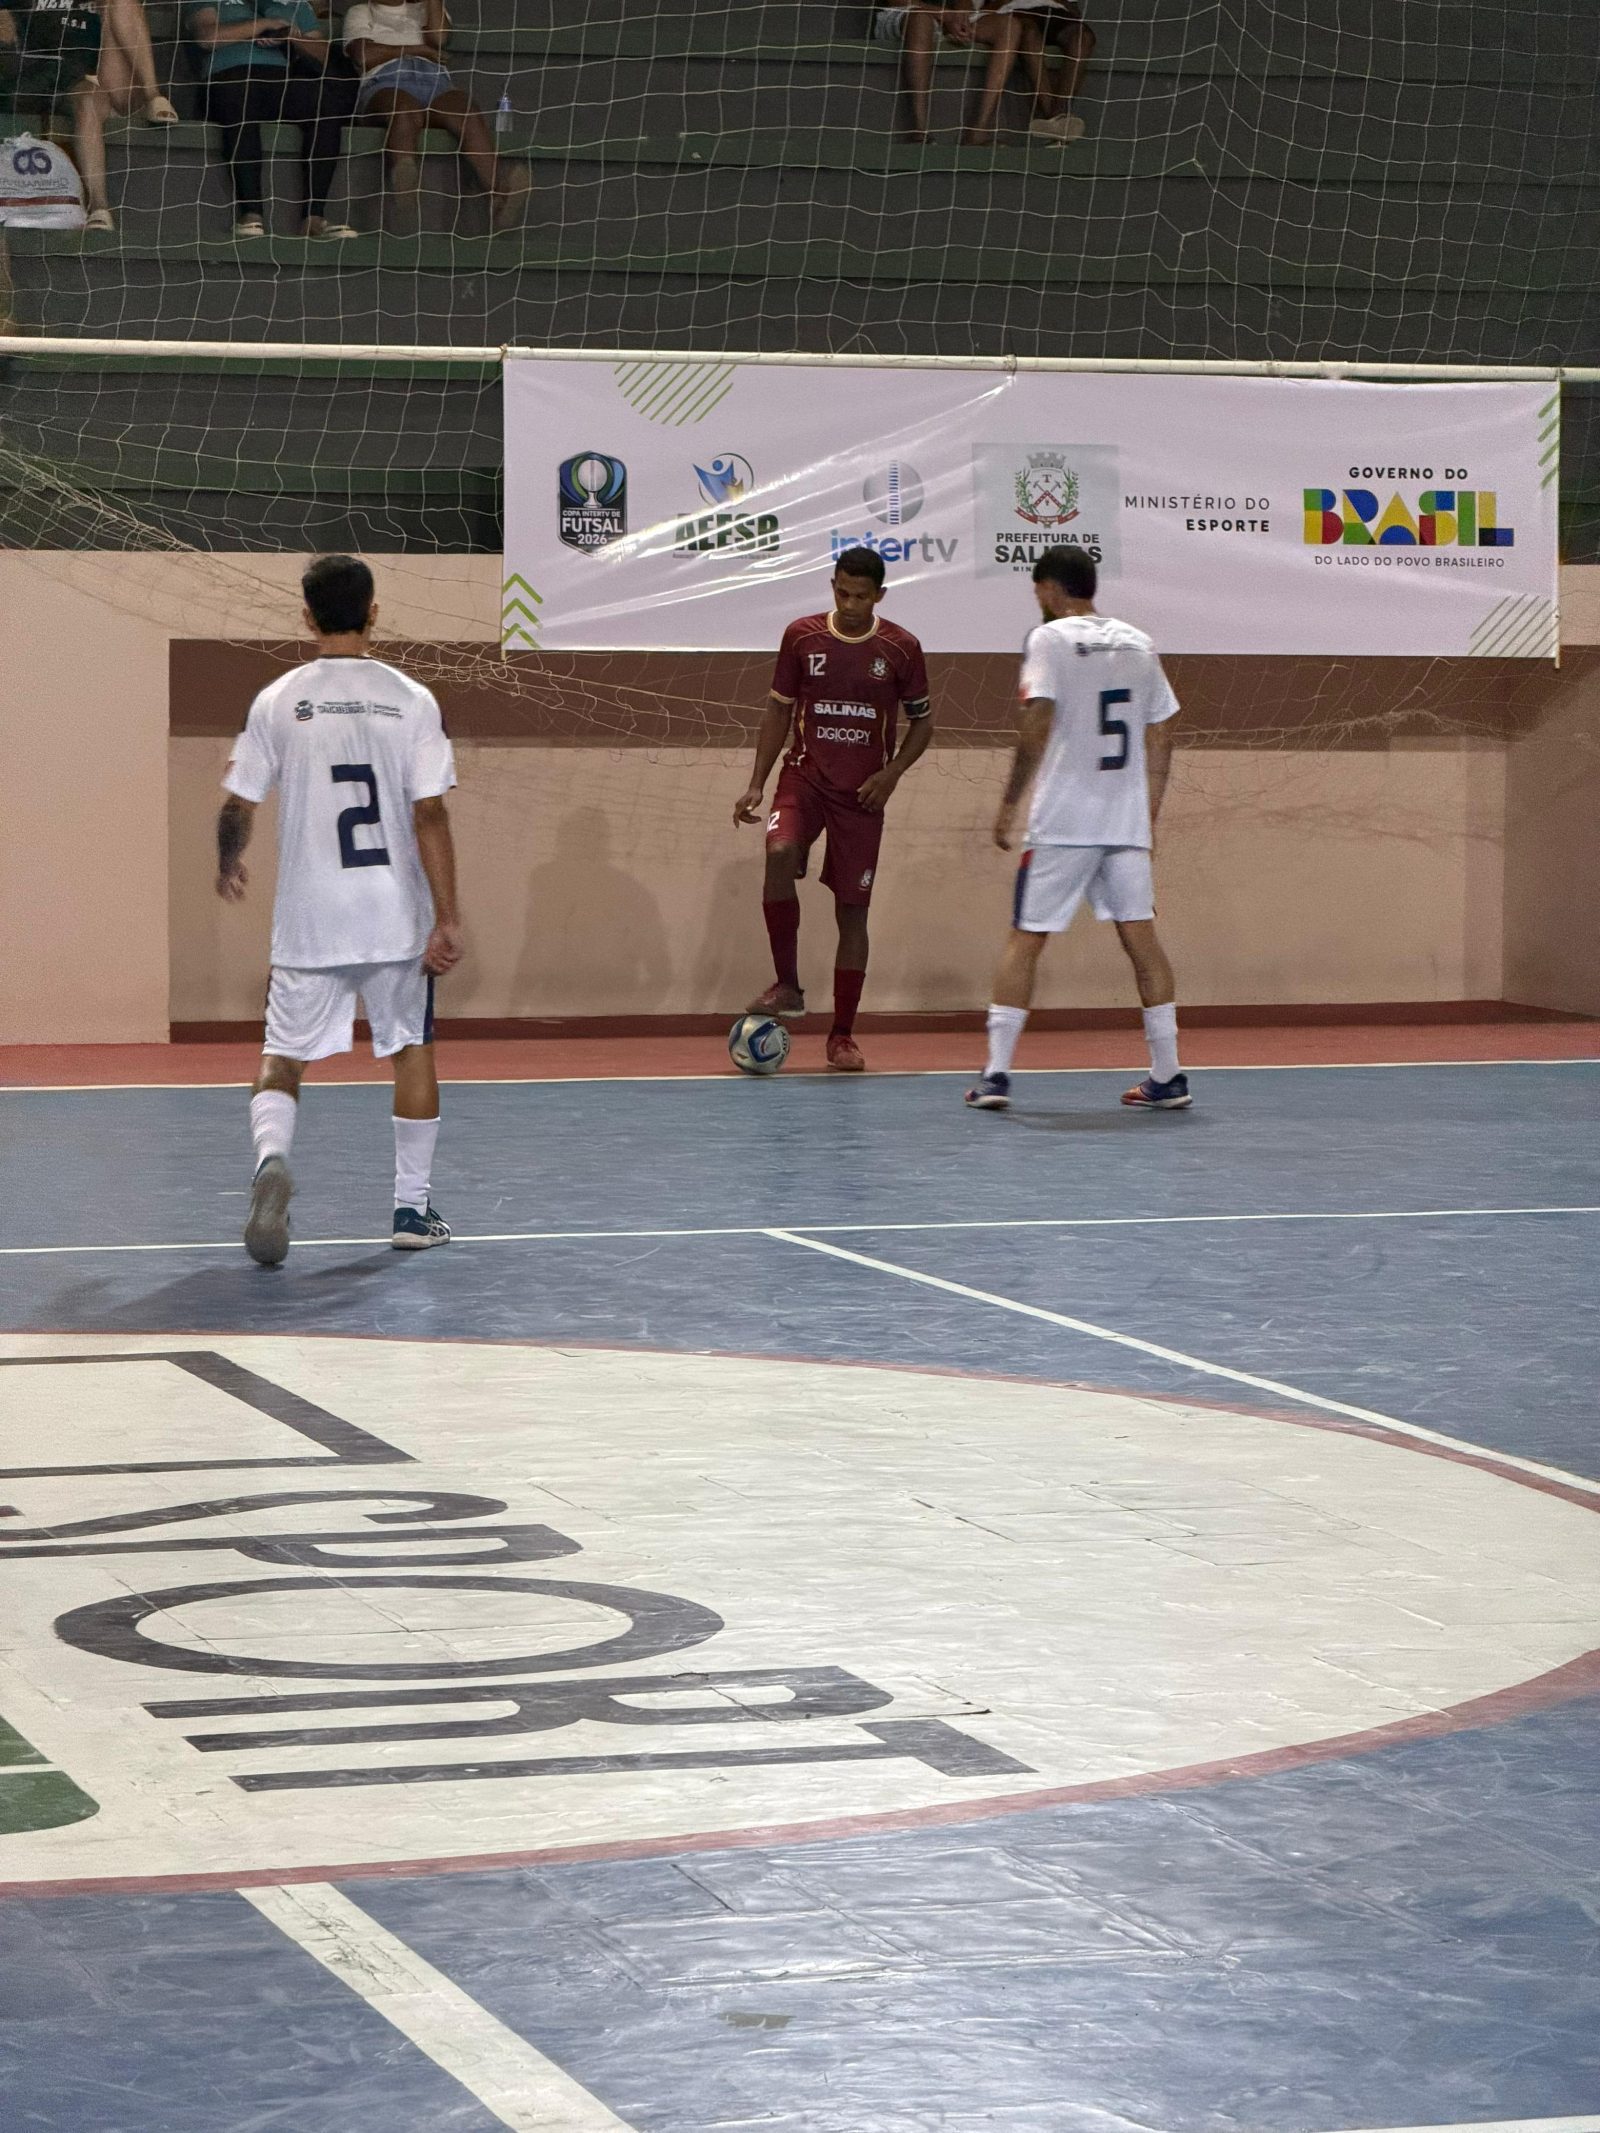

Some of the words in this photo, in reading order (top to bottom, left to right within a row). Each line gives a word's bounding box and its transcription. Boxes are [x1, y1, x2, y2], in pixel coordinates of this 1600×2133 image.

[1349, 467, 1434, 480] GOVERNO
[1445, 468, 1468, 480] DO
[1125, 494, 1236, 510] MINISTÉRIO
[1245, 498, 1270, 510] DO
[562, 518, 623, 533] FUTSAL
[1186, 519, 1270, 532] ESPORTE
[1303, 488, 1514, 547] BRASIL
[577, 534, 608, 545] 2026
[996, 533, 1079, 543] PREFEITURA
[1082, 534, 1100, 543] DE
[994, 545, 1103, 563] SALS
[1315, 556, 1332, 565] DO
[1337, 556, 1369, 566] LADO
[1375, 556, 1392, 566] DO
[1397, 557, 1431, 567] POVO
[1435, 557, 1505, 568] BRASILEIRO
[808, 653, 827, 676] 12
[813, 702, 877, 719] SALINAS
[817, 726, 871, 743] DIGICOPY
[1098, 688, 1131, 771] 5
[331, 763, 391, 869] 2
